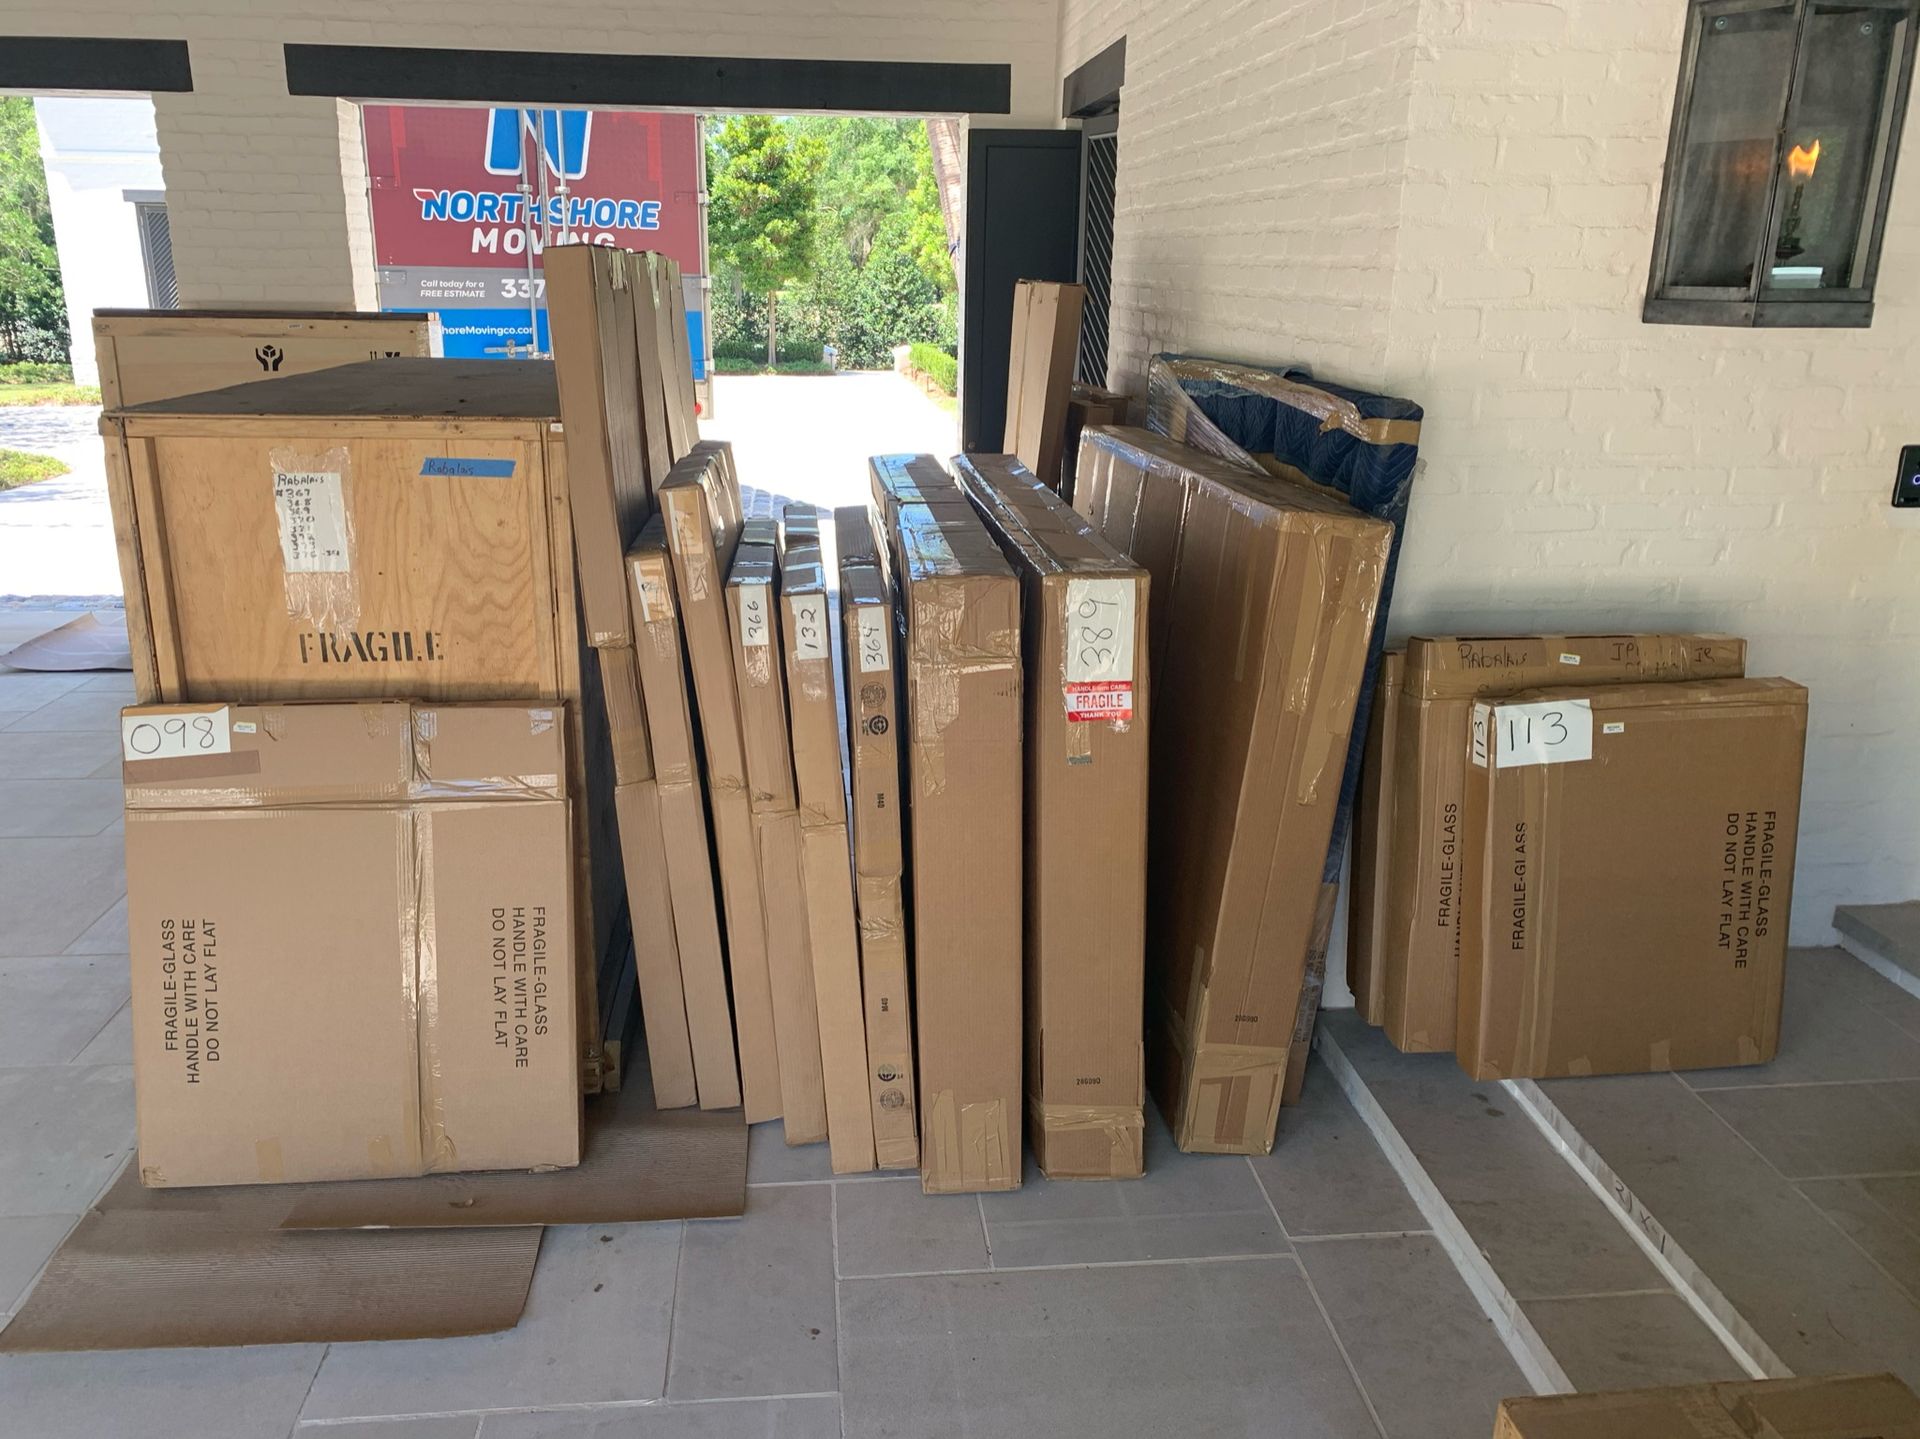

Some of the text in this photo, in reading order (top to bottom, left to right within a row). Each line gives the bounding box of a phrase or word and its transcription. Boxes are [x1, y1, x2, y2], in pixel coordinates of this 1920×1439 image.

[413, 188, 661, 231] NORTHSHORE
[420, 280, 438, 288] Call
[440, 280, 464, 290] today
[465, 280, 477, 288] for
[420, 290, 485, 298] FREE ESTIMATE
[501, 279, 546, 298] 337
[747, 600, 763, 639] 366
[800, 608, 819, 650] 132
[1078, 598, 1119, 667] 389
[299, 631, 445, 664] FRAGILE
[862, 626, 885, 665] 364
[1076, 693, 1124, 709] FRAGILE
[1080, 711, 1105, 719] THANK
[130, 715, 215, 755] 098
[1510, 711, 1568, 752] 113
[1438, 803, 1457, 927] FRAGILE-GLASS
[1718, 813, 1739, 949] DO NOT LAY FLAT
[1755, 811, 1776, 937] FRAGILE-GLASS
[1735, 812, 1758, 969] HANDLE WITH CARE
[161, 919, 178, 1051] FRAGILE-GLASS
[202, 918, 220, 1061] DO NOT LAY FLAT
[492, 908, 508, 1047] DO NOT LAY FLAT
[512, 907, 528, 1068] HANDLE WITH CARE
[533, 907, 548, 1036] FRAGILE-GLASS
[182, 919, 200, 1083] HANDLE WITH CARE
